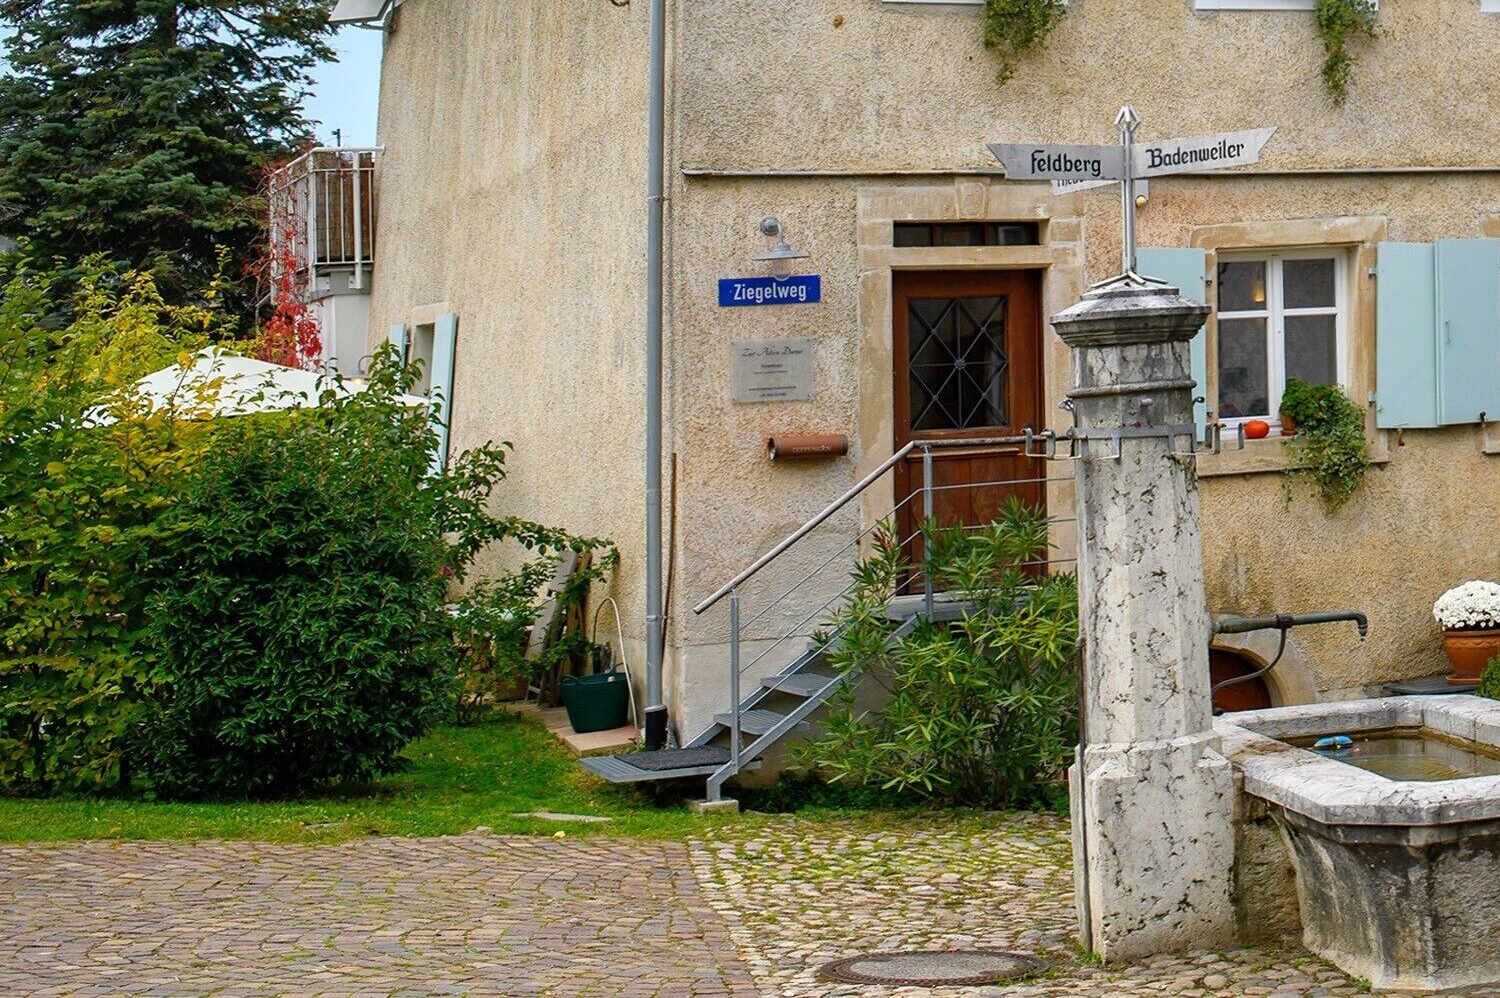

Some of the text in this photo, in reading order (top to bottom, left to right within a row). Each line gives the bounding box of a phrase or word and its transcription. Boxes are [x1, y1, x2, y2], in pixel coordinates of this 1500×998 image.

[1031, 149, 1101, 177] Feldberg
[1145, 139, 1245, 169] Badenweiler
[733, 282, 807, 304] Ziegelweg
